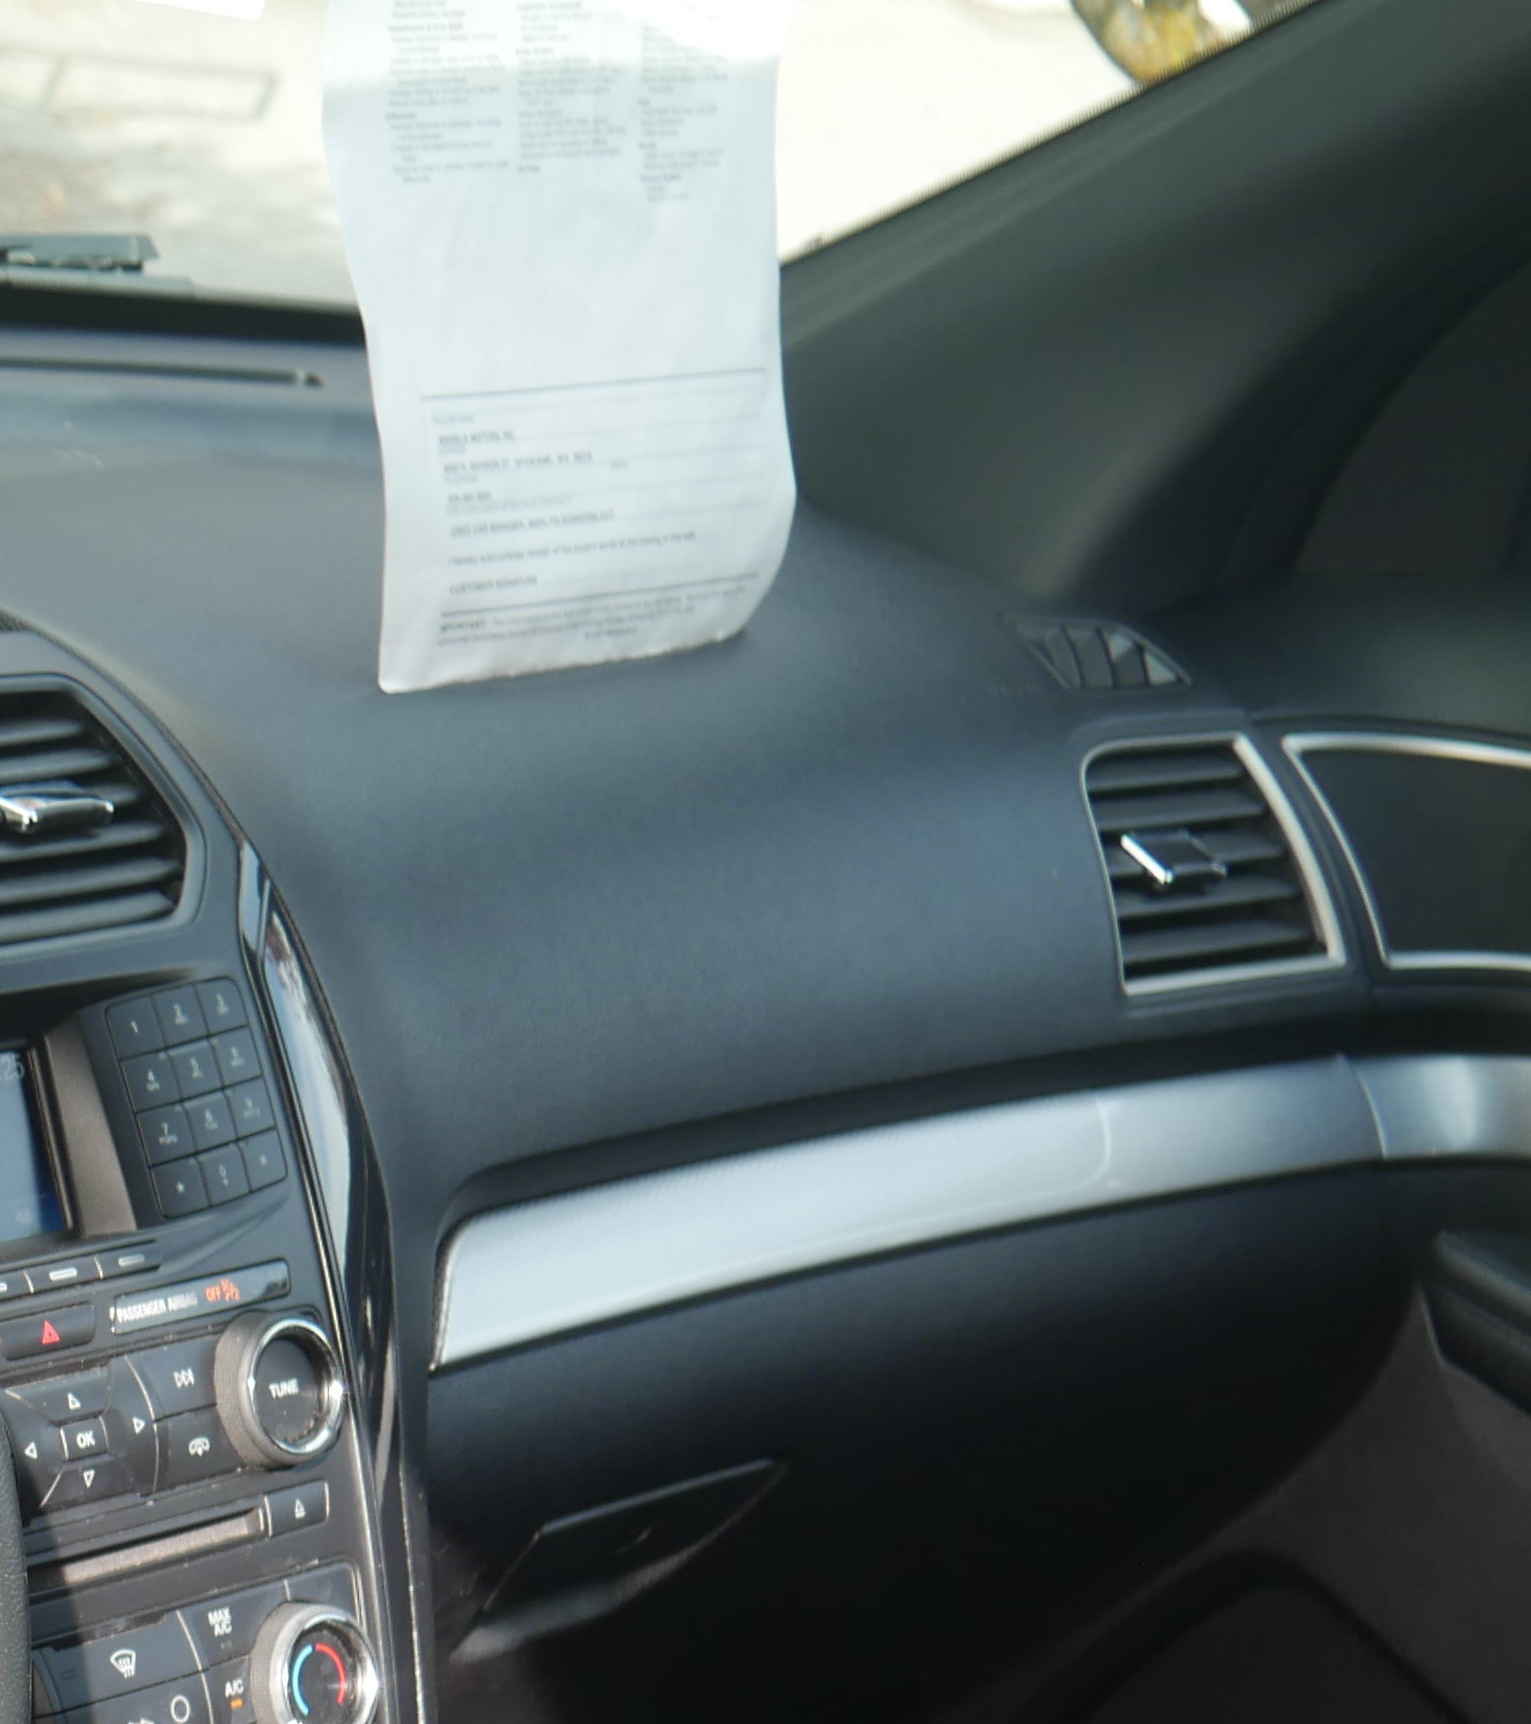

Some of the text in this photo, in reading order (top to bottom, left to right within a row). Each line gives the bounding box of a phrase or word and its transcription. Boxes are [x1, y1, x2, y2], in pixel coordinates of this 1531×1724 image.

[116, 1298, 166, 1324] PASSENGER
[205, 1286, 221, 1303] OFF
[269, 1378, 299, 1399] TUNE
[77, 1430, 96, 1449] OK
[208, 1606, 231, 1626] MAX
[214, 1621, 233, 1637] A/C
[225, 1679, 245, 1698] A/C
